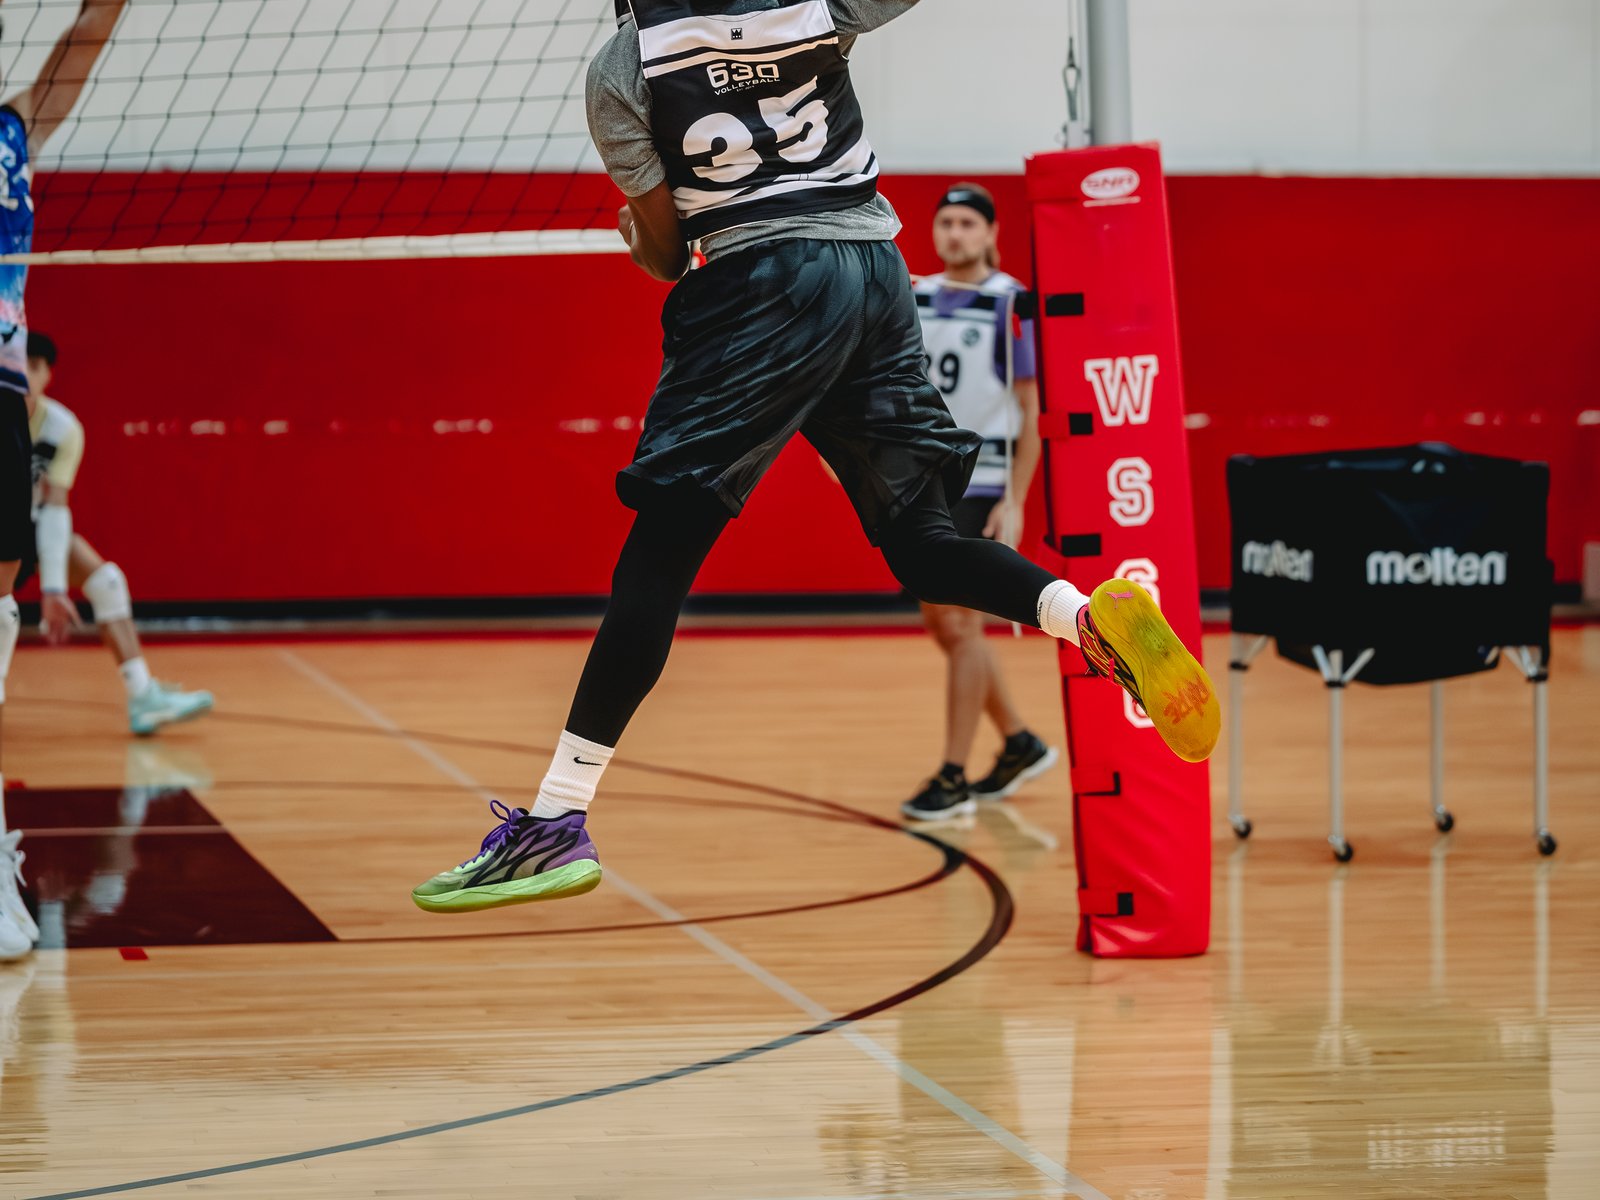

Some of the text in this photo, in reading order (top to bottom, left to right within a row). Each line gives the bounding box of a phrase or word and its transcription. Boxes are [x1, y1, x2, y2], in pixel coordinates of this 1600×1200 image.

[706, 62, 780, 88] 630
[714, 78, 781, 96] VOLLEYBALL
[683, 75, 829, 183] 35
[924, 352, 960, 395] 9
[1366, 547, 1507, 586] molten
